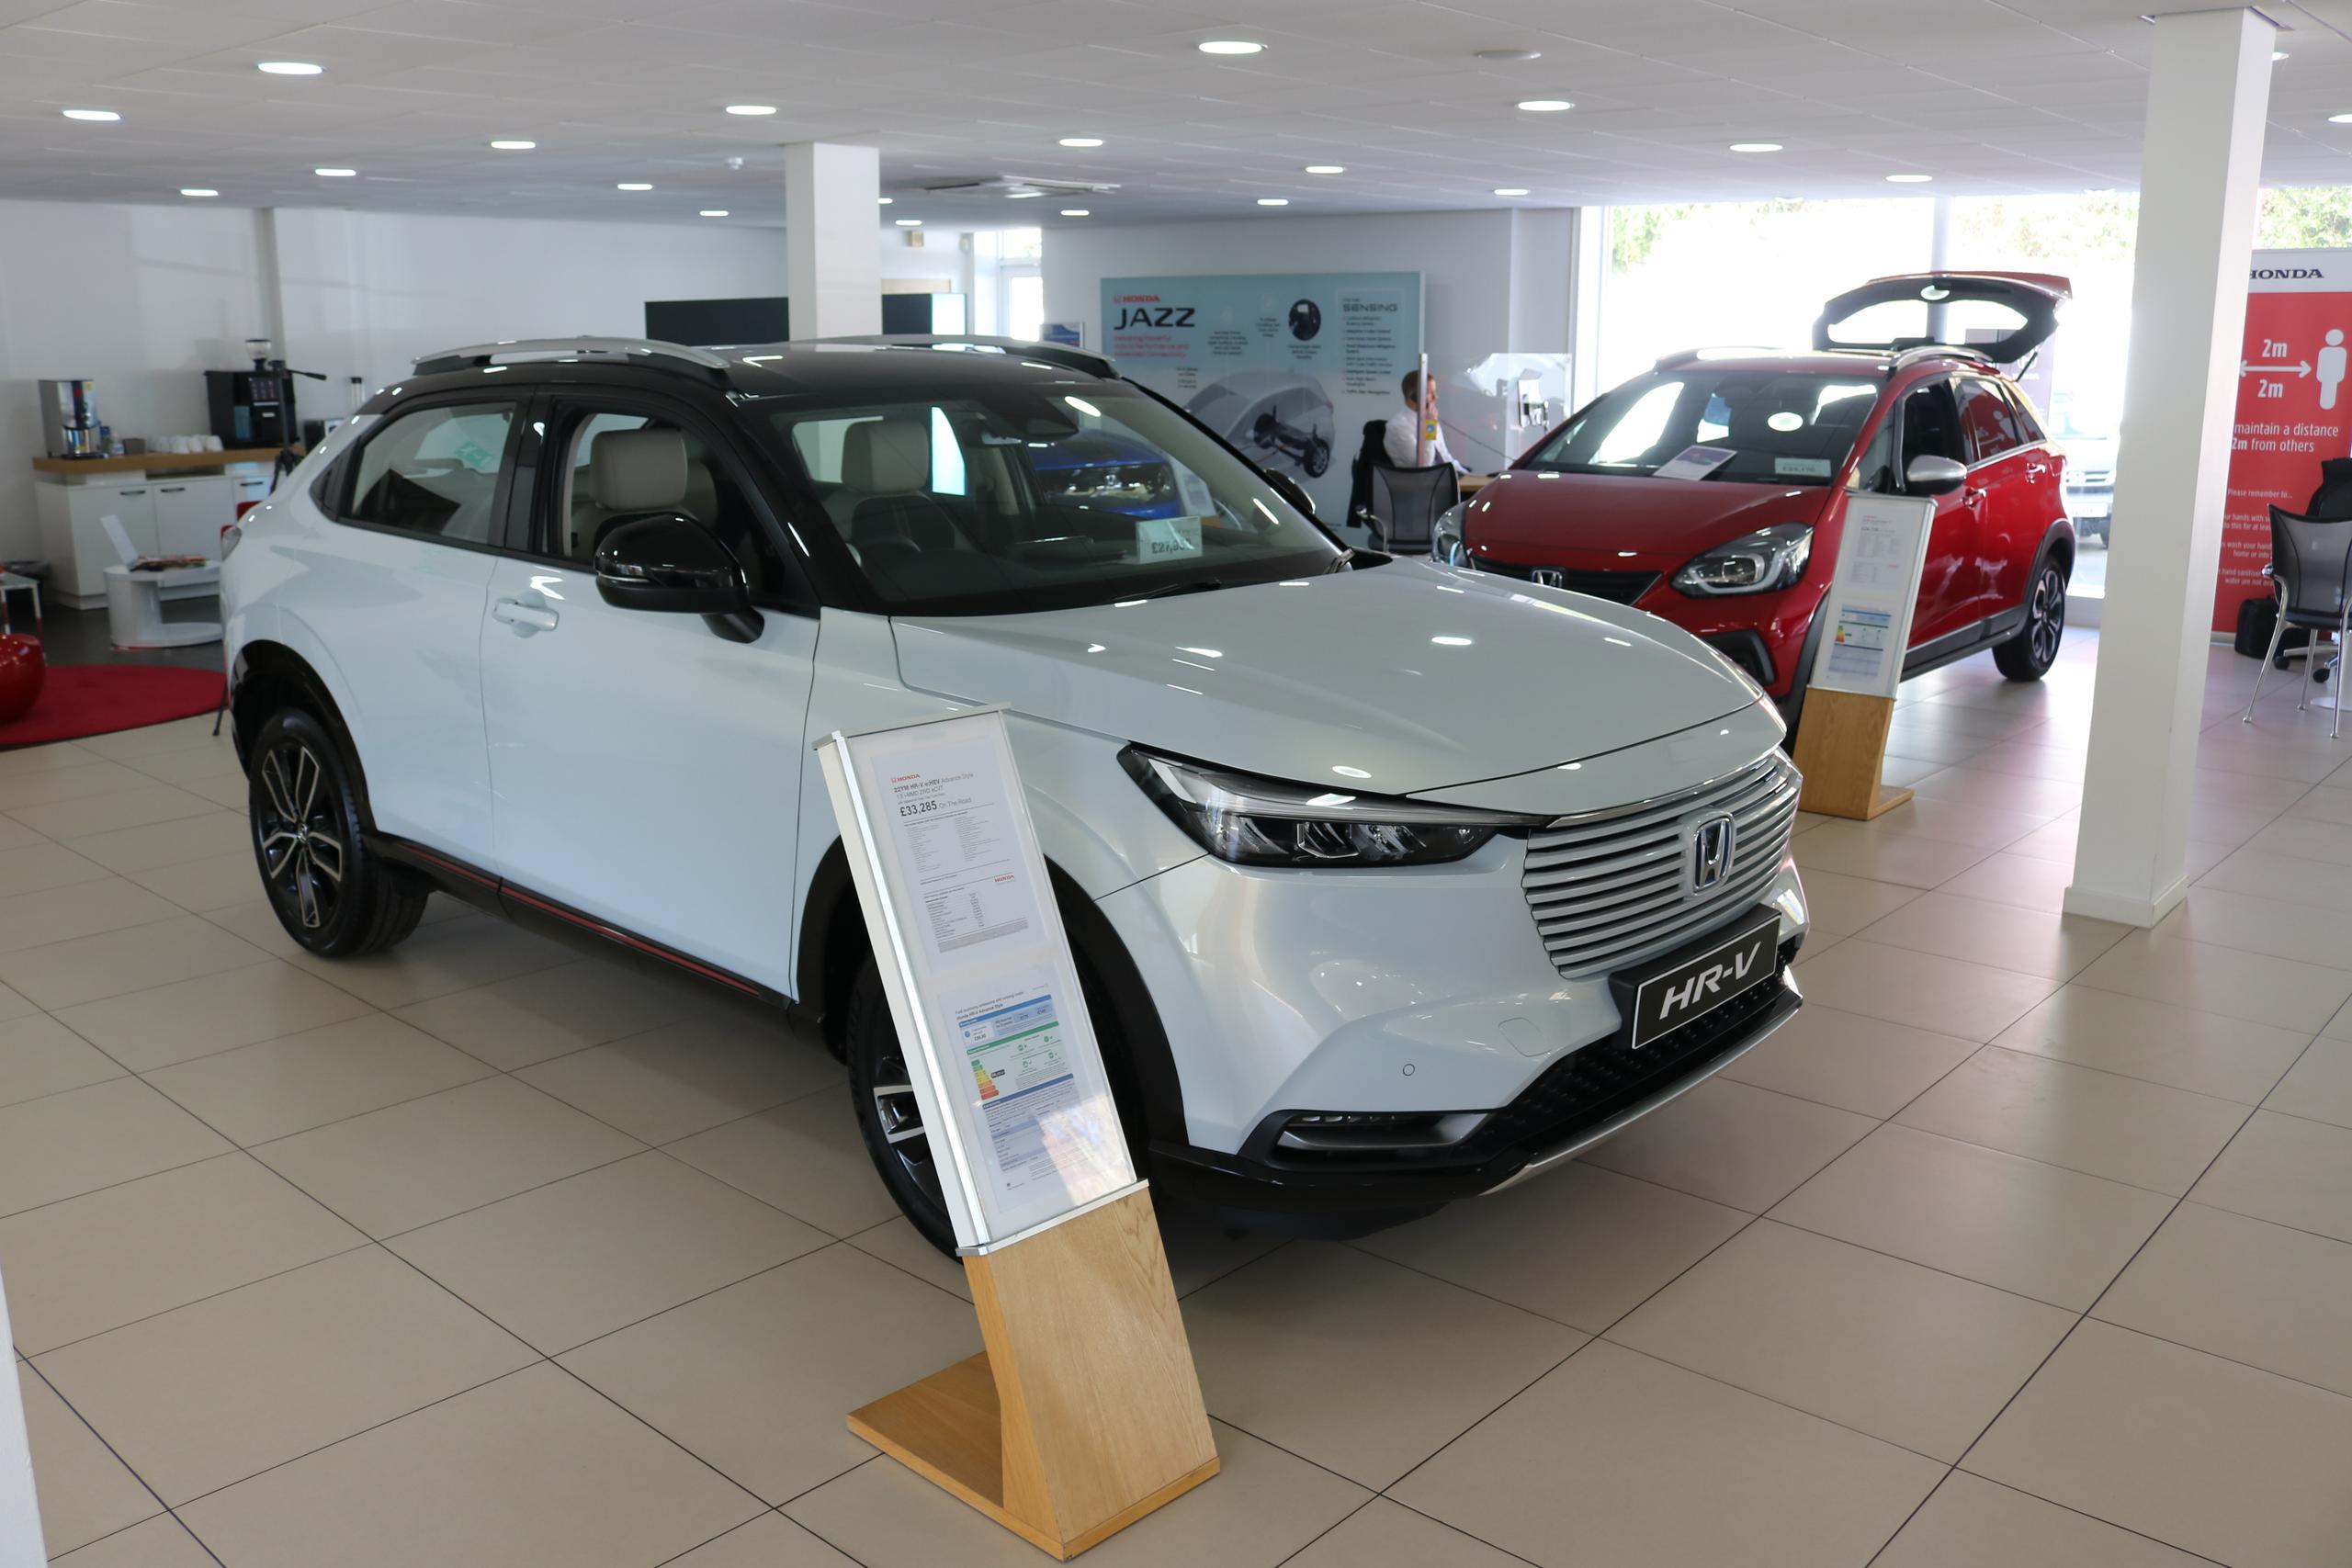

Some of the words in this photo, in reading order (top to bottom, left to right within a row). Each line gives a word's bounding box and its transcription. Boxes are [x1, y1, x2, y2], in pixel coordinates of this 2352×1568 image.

[1343, 303, 1397, 312] SENSING
[1114, 308, 1195, 330] JAZZ
[2261, 339, 2288, 358] 2m
[2257, 379, 2284, 399] 2m
[2233, 422, 2279, 435] maintain
[2283, 425, 2290, 436] a
[2293, 423, 2339, 437] distance
[2232, 437, 2247, 450] 2m
[2251, 438, 2276, 451] from
[2279, 439, 2314, 453] others
[2227, 488, 2247, 496] Please
[2247, 490, 2279, 498] remember
[897, 773, 921, 783] HONDA
[910, 782, 923, 790] HR-V
[899, 800, 938, 817] £33,285
[957, 796, 972, 805] Road
[1659, 941, 1761, 1021] HR-V
